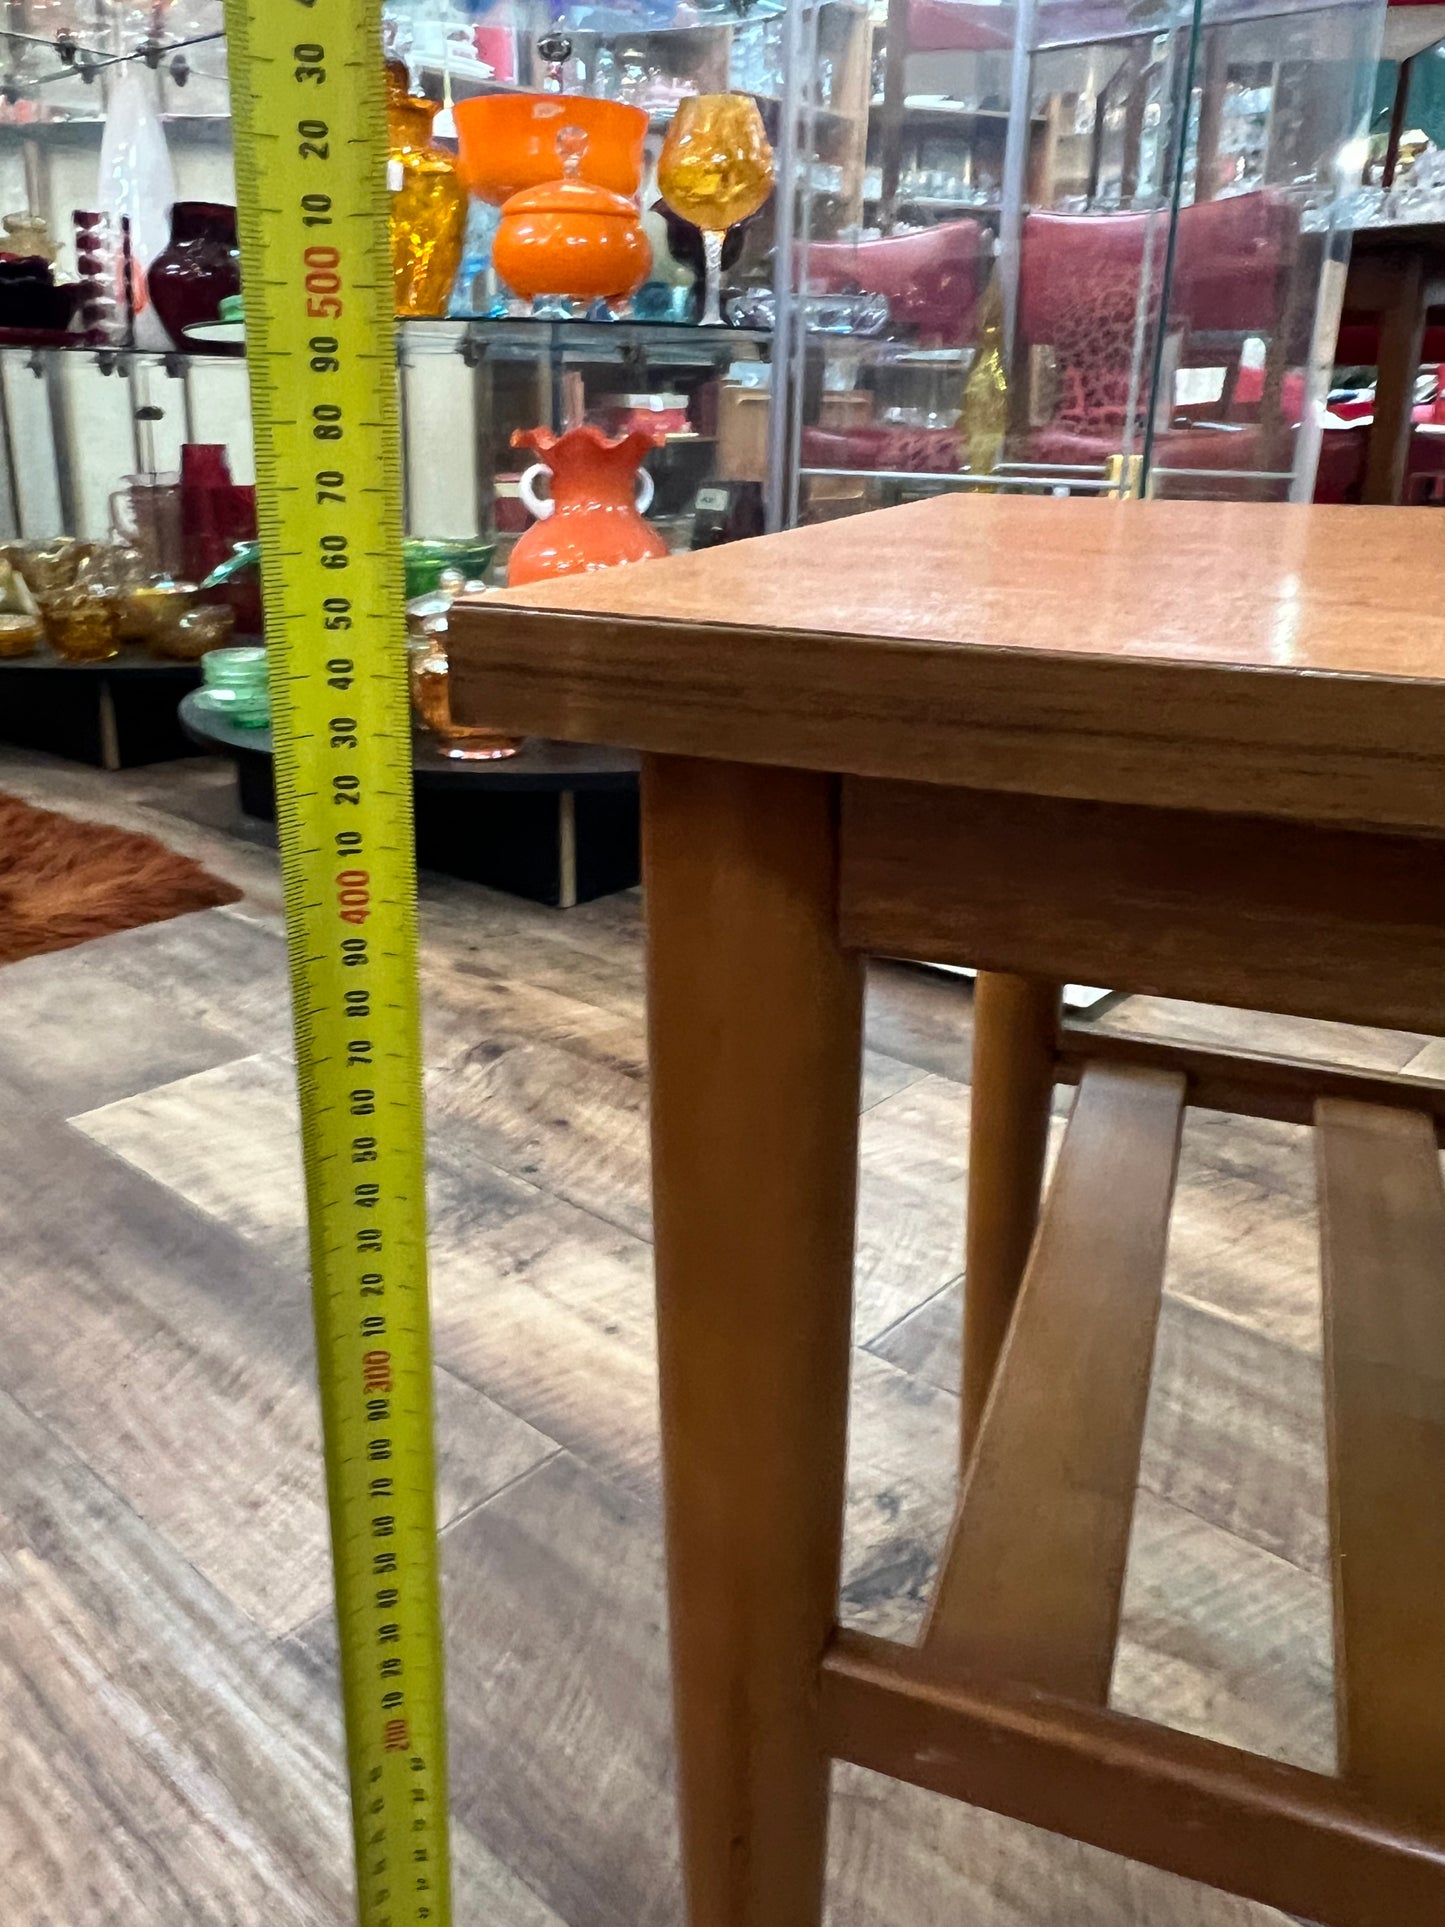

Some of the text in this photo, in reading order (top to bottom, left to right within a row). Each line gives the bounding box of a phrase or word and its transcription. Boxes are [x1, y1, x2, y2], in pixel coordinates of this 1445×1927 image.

[294, 44, 325, 84] 30
[298, 120, 329, 160] 20
[301, 194, 332, 227] 10
[304, 247, 342, 318] 500
[309, 337, 339, 372] 90
[312, 405, 343, 440] 80
[316, 471, 345, 504] 70
[320, 536, 348, 569] 60
[323, 598, 351, 630] 50
[326, 659, 354, 690] 40
[329, 718, 357, 748] 30
[333, 776, 360, 805] 20
[335, 832, 362, 857] 10
[336, 871, 370, 924] 400
[340, 939, 368, 966] 90
[343, 990, 370, 1017] 80
[346, 1041, 373, 1067] 70
[348, 1090, 375, 1115] 60
[351, 1137, 377, 1163] 50
[354, 1184, 379, 1207] 40
[356, 1229, 382, 1252] 30
[358, 1274, 384, 1297] 20
[360, 1317, 386, 1337] 10
[362, 1351, 391, 1395] 300
[368, 1478, 393, 1498] 70
